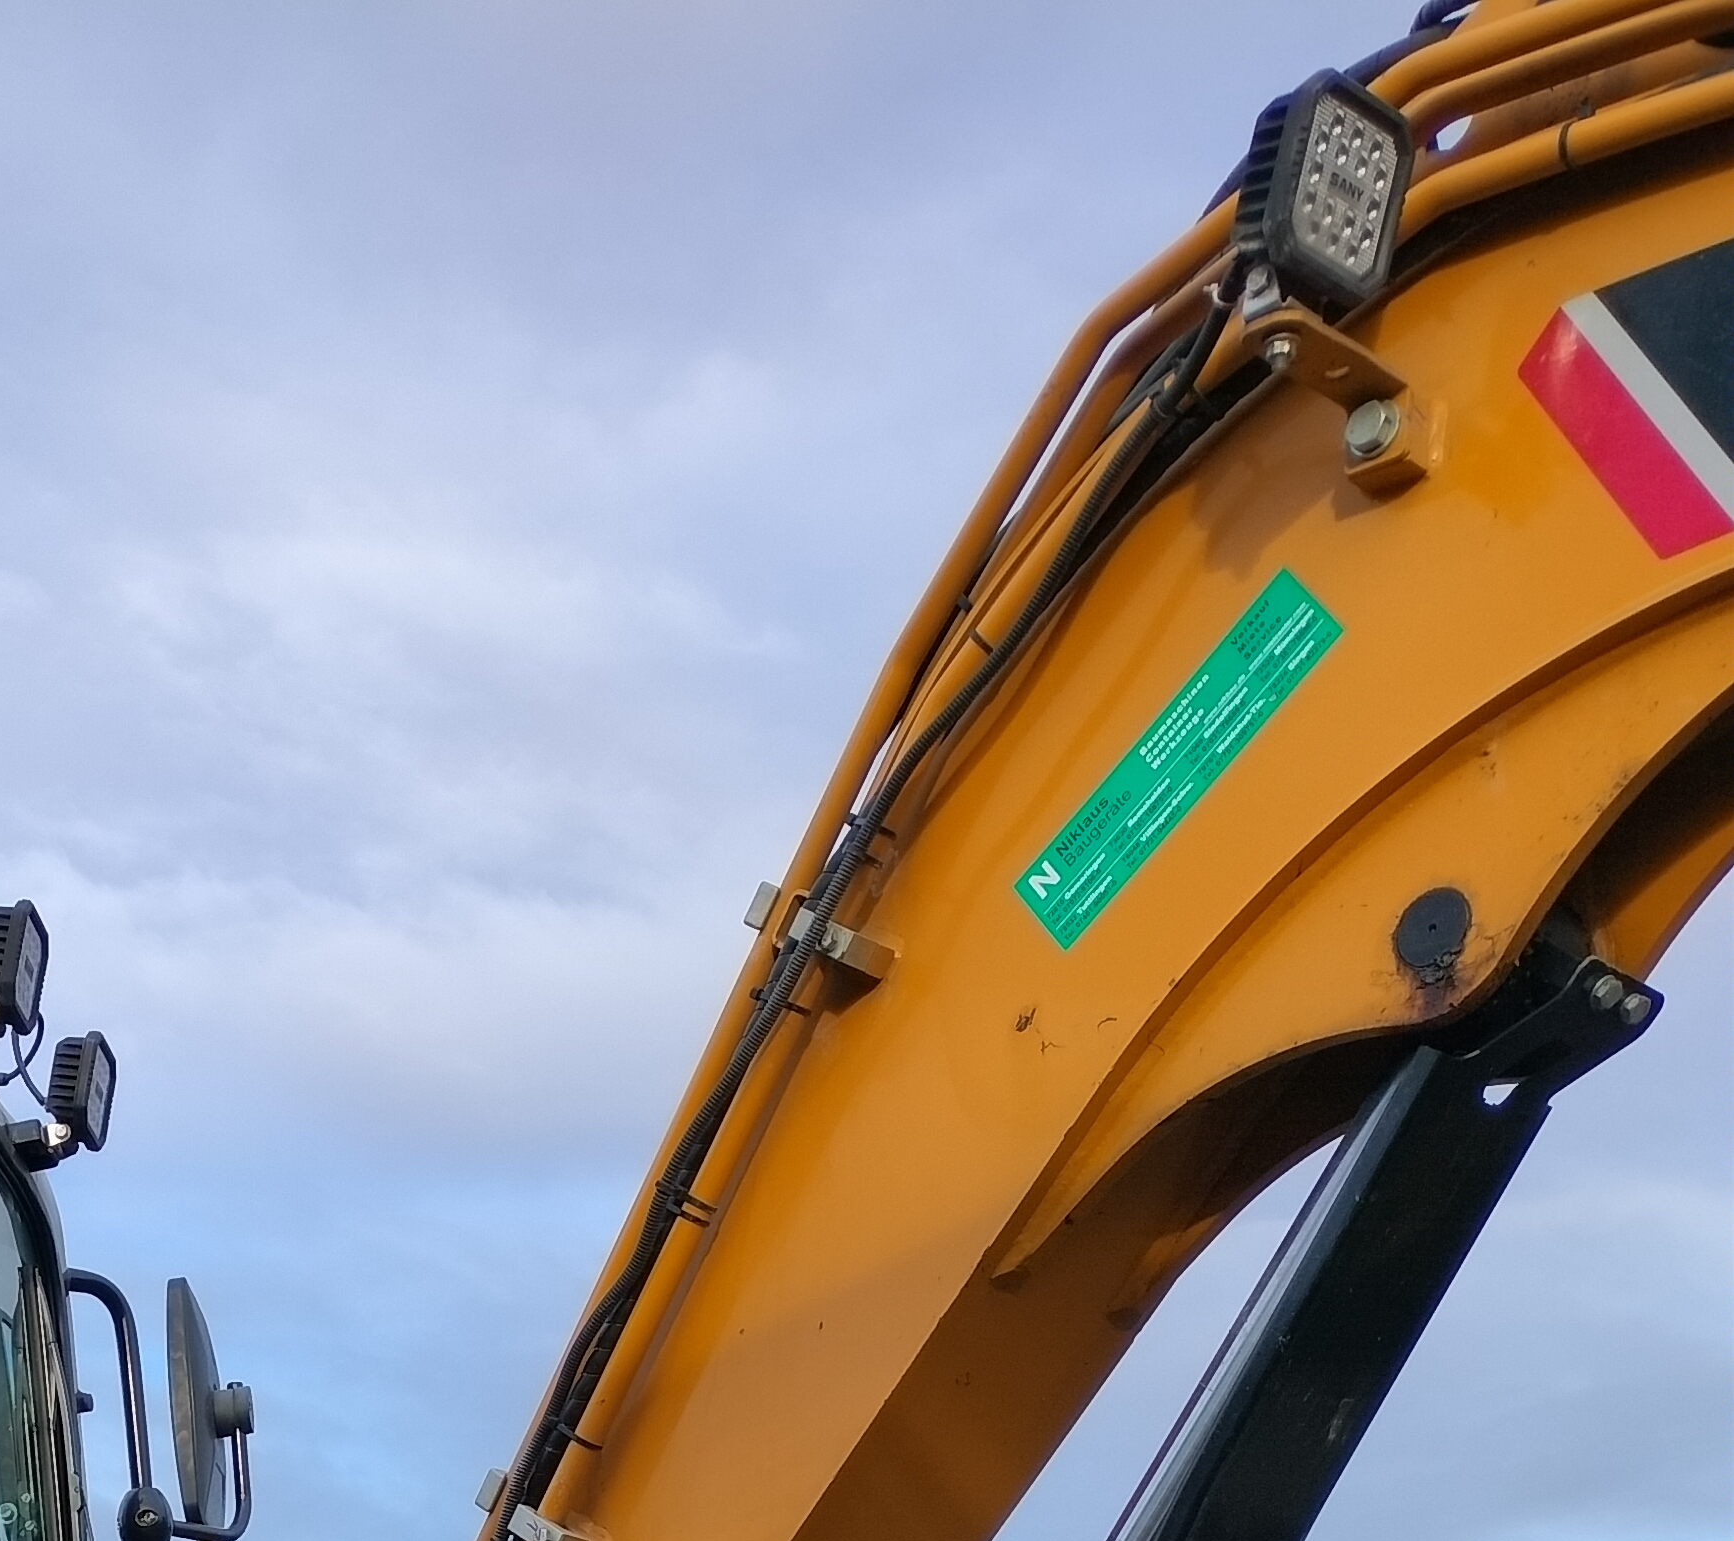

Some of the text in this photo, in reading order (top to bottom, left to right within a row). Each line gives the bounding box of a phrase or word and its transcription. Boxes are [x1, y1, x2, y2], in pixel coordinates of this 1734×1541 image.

[1329, 171, 1365, 202] SANY
[1228, 598, 1271, 647] Verkauf
[1235, 618, 1266, 654] Miete
[1241, 613, 1283, 661] Service
[1054, 793, 1110, 858] Niklaus
[1062, 785, 1134, 870] Baugeräte
